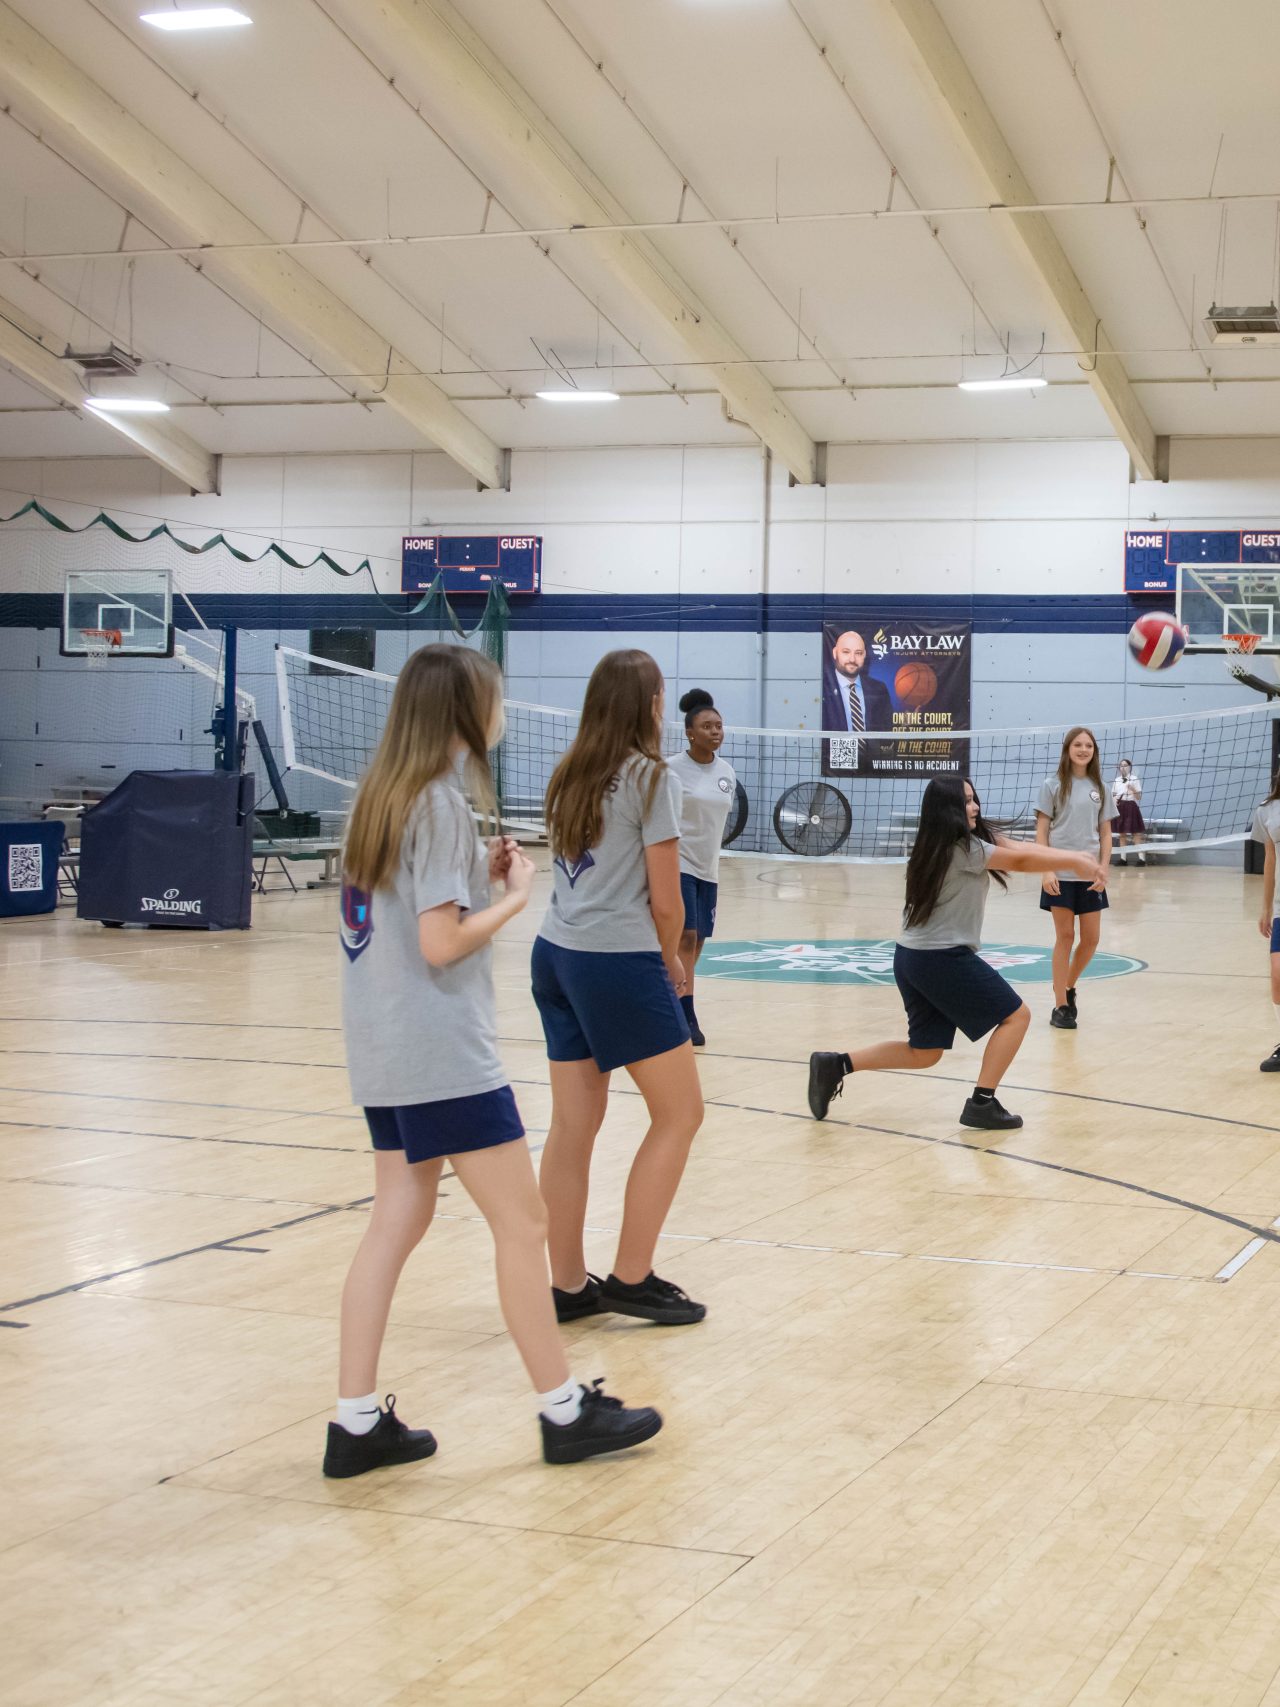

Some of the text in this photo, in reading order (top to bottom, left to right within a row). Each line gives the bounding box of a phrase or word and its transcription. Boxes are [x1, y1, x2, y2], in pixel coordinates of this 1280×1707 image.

[405, 539, 434, 550] HOME
[501, 539, 534, 549] GUEST
[1127, 535, 1163, 548] HOME
[890, 636, 965, 649] BAY LAW
[893, 713, 953, 726] ON THE COURT,
[897, 742, 907, 753] IN
[909, 742, 923, 753] THE
[924, 742, 952, 753] COURT
[872, 760, 960, 770] WINNING IS NO ACCIDENT
[141, 897, 202, 914] SPALDING
